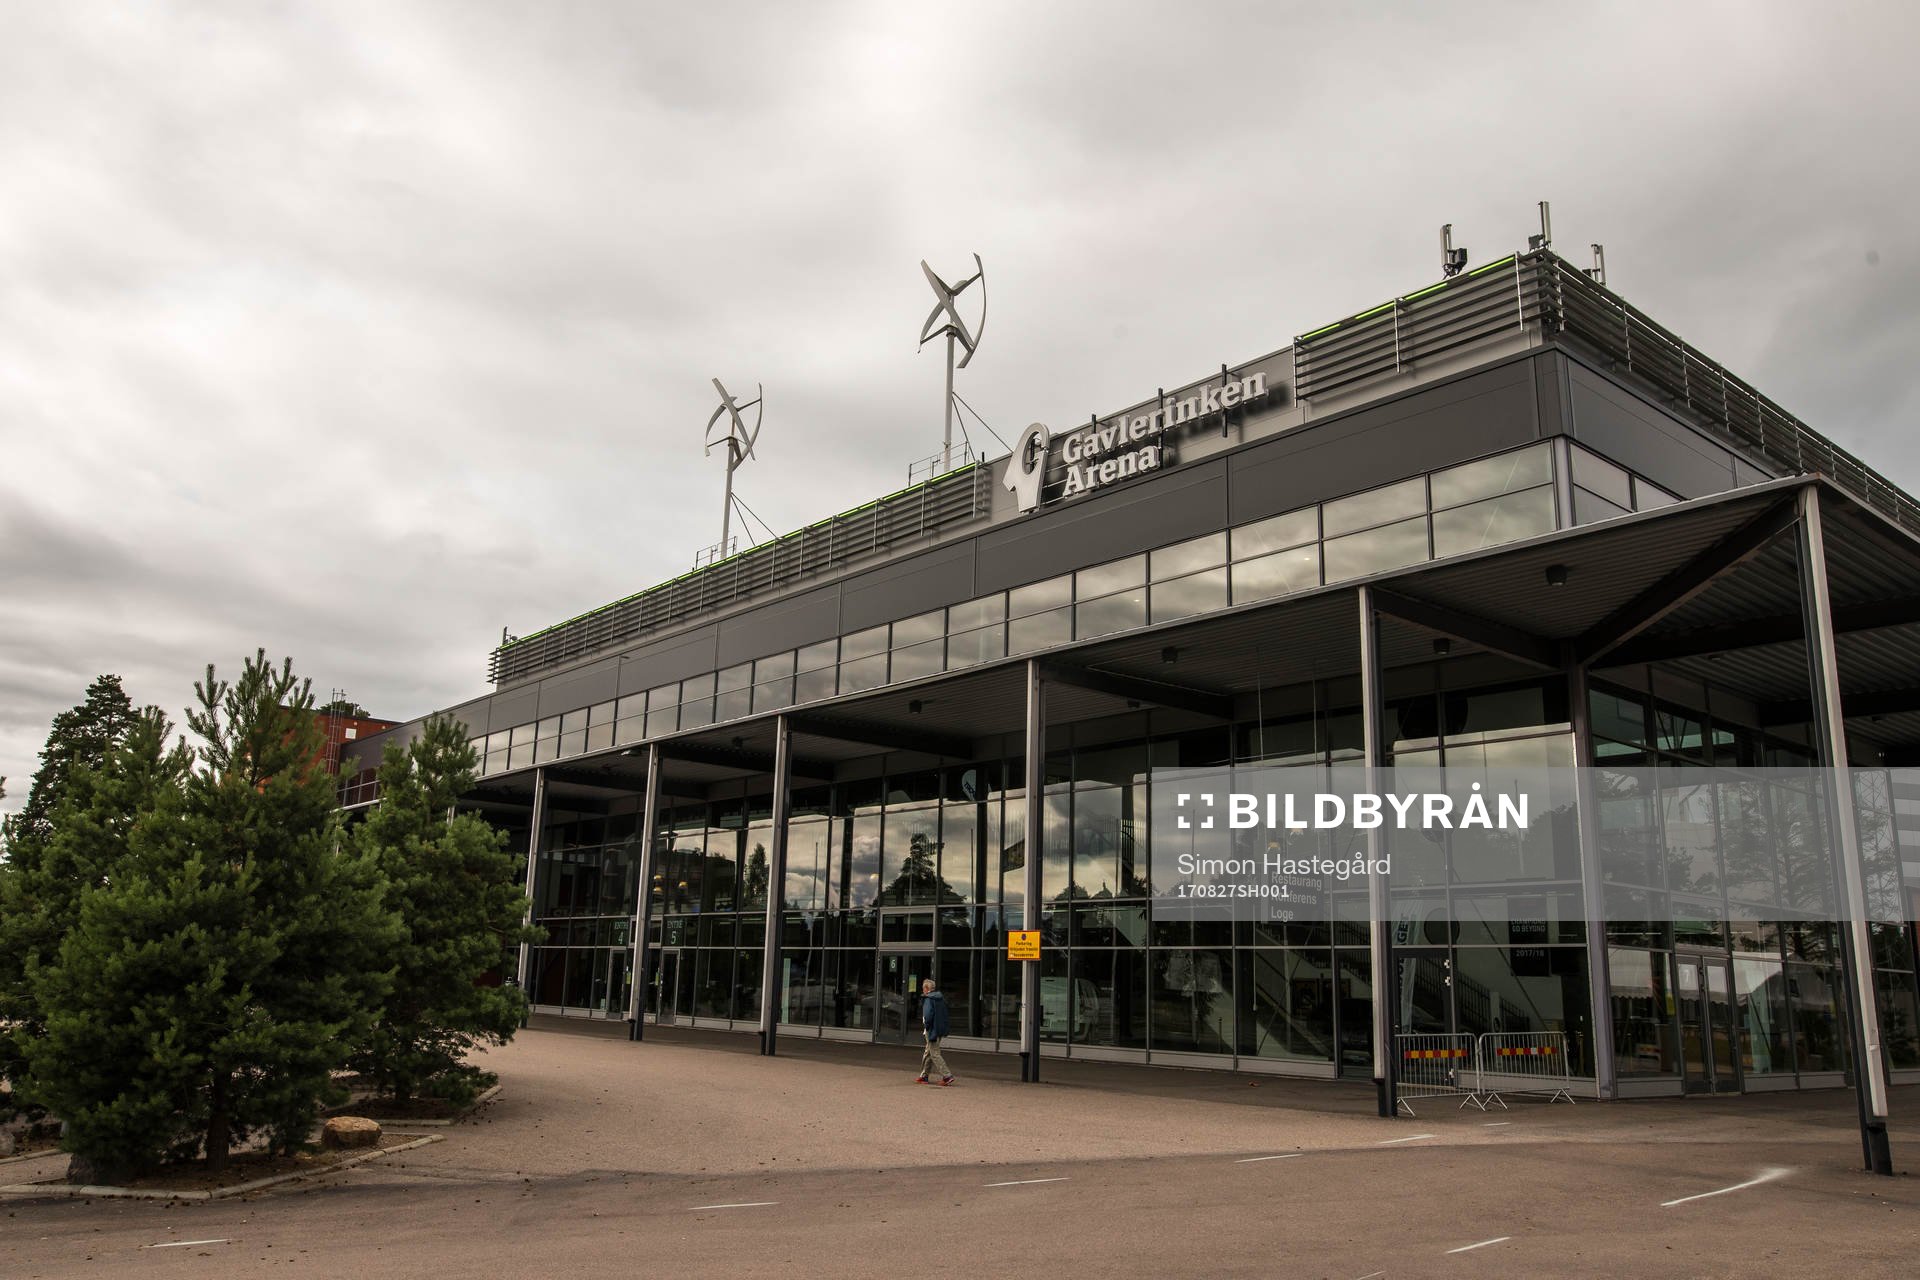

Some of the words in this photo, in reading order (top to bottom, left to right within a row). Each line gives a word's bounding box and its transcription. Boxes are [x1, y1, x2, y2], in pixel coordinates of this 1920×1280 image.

[1062, 371, 1270, 465] Gavlerinken
[1062, 445, 1163, 500] Arena
[1271, 871, 1323, 891] Restaurang
[1271, 906, 1294, 922] Loge
[617, 931, 624, 945] 4
[670, 930, 677, 945] 5
